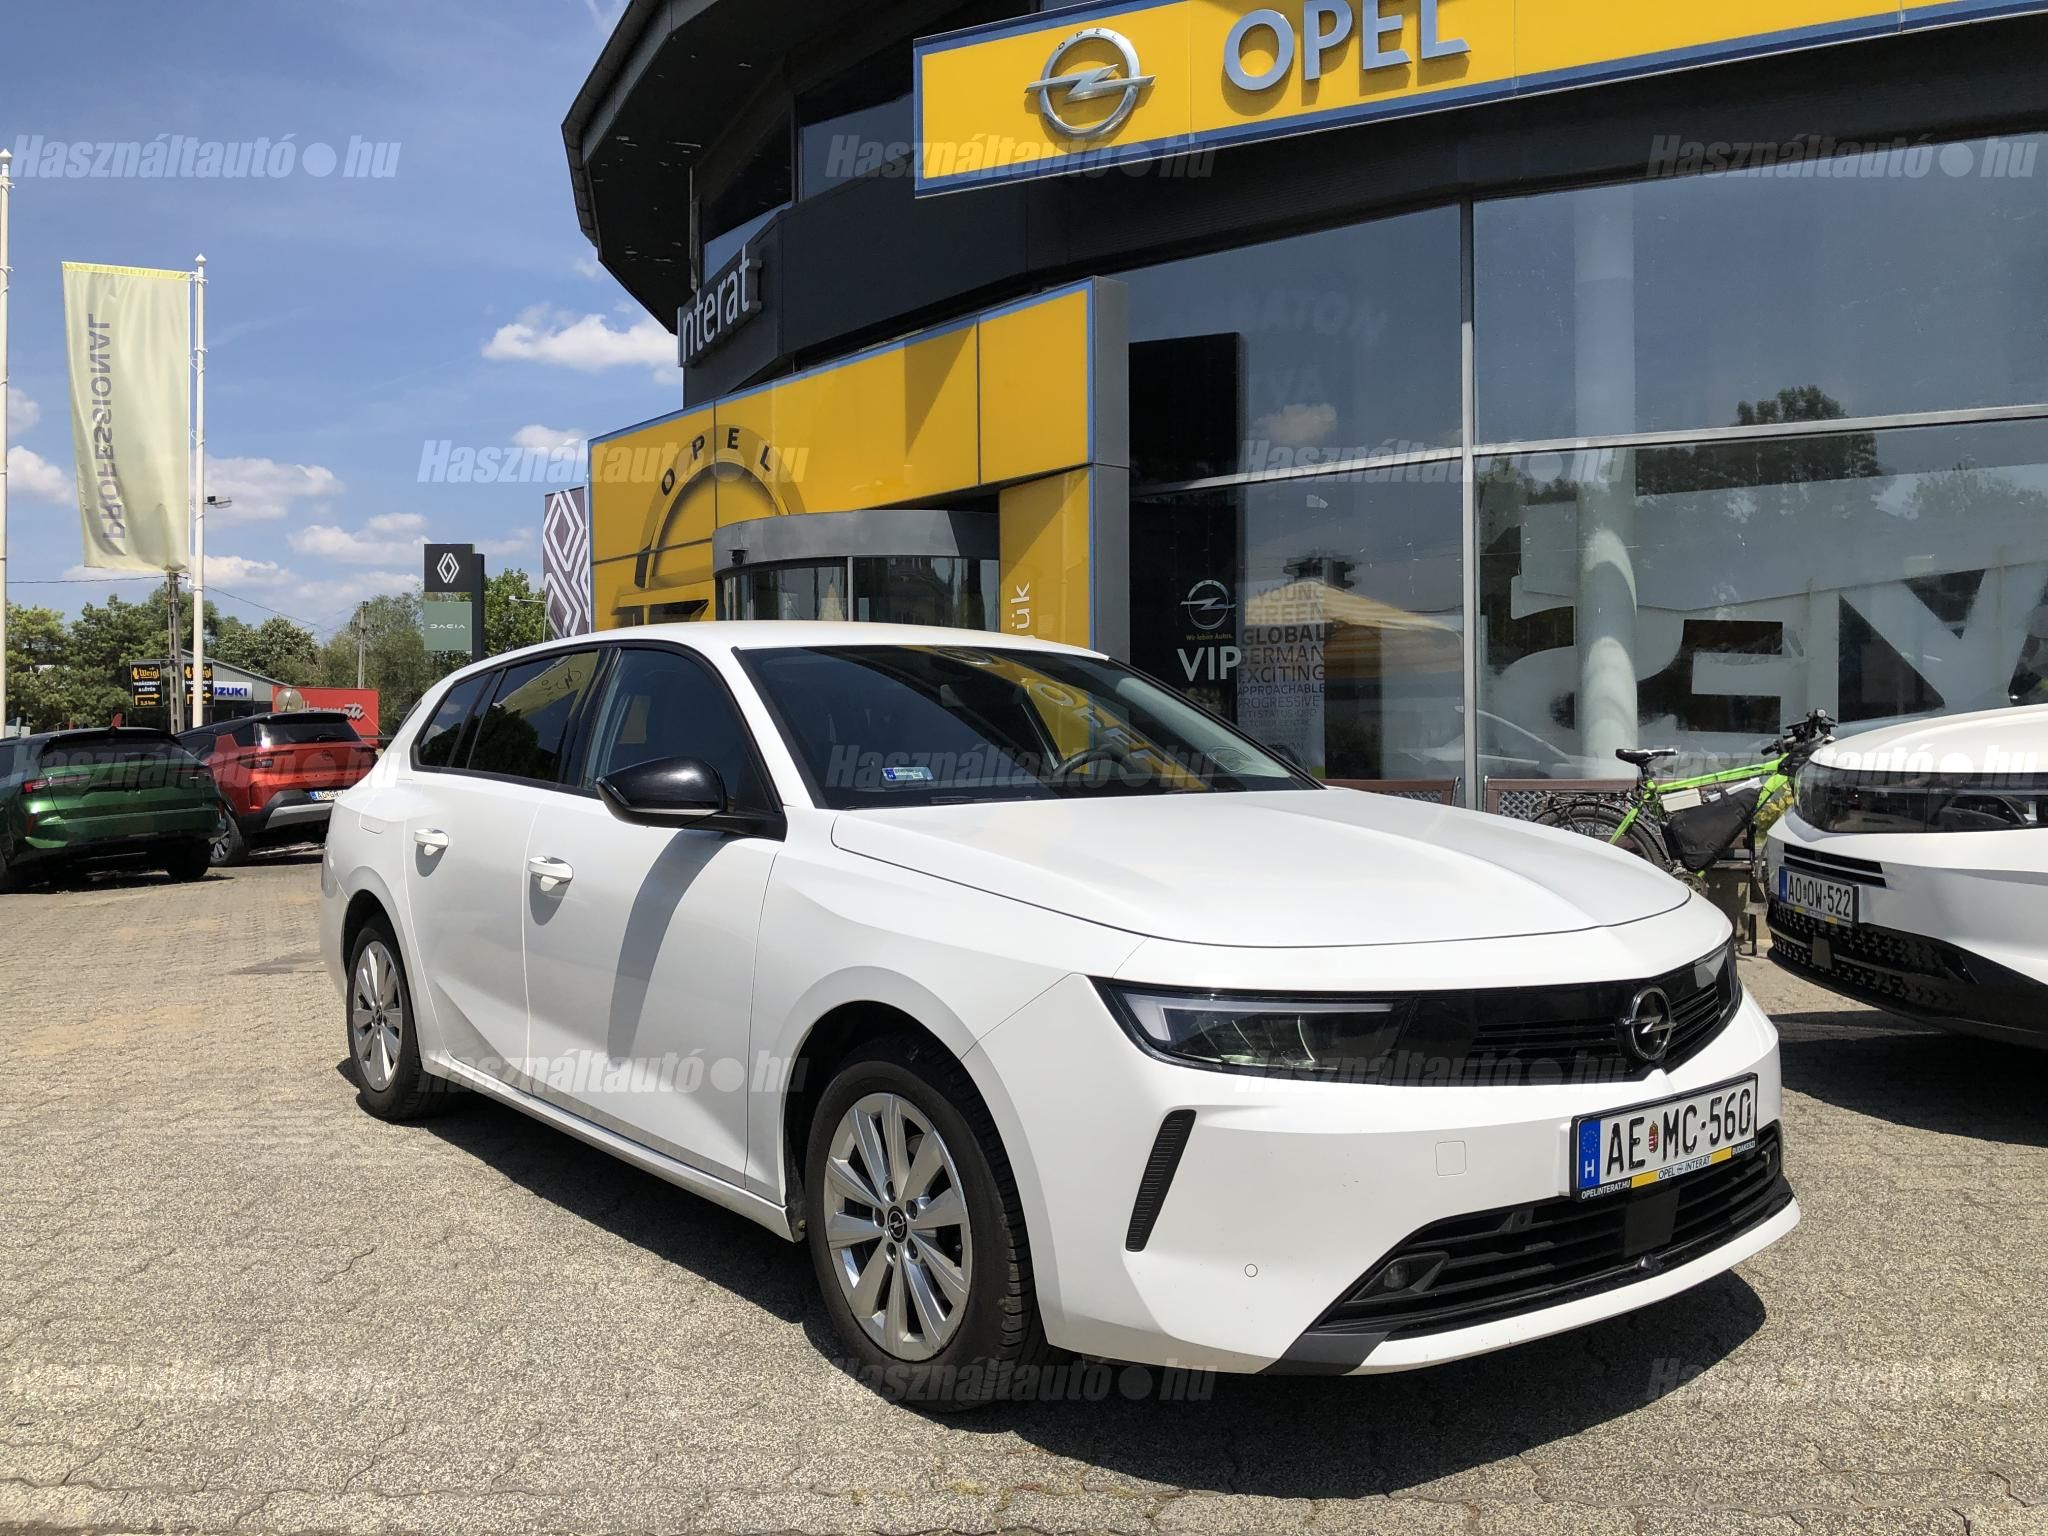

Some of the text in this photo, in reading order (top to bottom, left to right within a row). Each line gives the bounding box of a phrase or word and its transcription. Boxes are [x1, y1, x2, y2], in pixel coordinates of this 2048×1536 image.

[1224, 0, 1471, 90] OPEL
[661, 427, 771, 496] OPEL
[1241, 624, 1325, 646] GLOBAL
[1177, 646, 1242, 682] VIP
[1584, 1159, 1595, 1179] H
[1658, 1156, 1711, 1180] OPEL INTERAT
[1581, 1179, 1631, 1200] OPELINTERAT.HU
